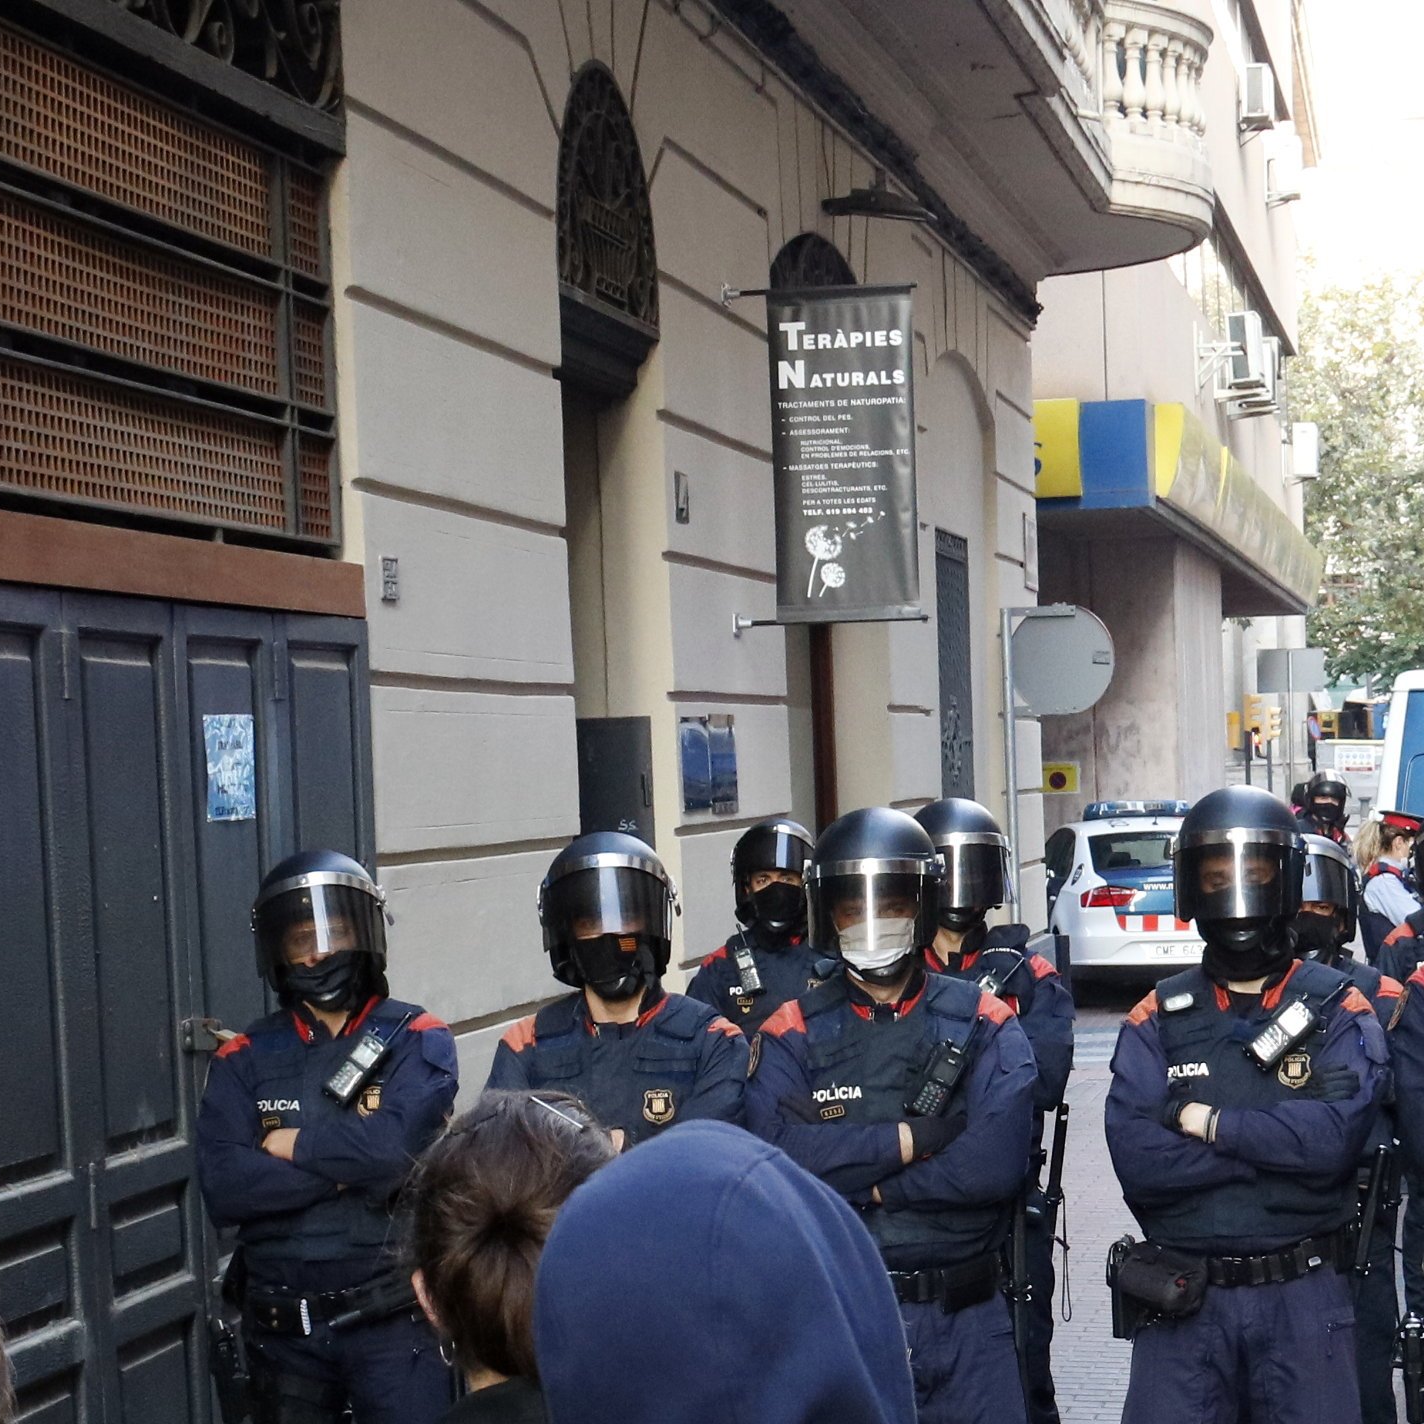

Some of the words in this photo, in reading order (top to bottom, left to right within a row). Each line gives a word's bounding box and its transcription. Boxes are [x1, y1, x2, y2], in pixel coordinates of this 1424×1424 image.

[779, 322, 903, 351] TERÀPIES
[778, 360, 905, 390] NATURALS
[778, 400, 835, 409] TRACTAMENTS
[789, 415, 821, 423] CONTROL
